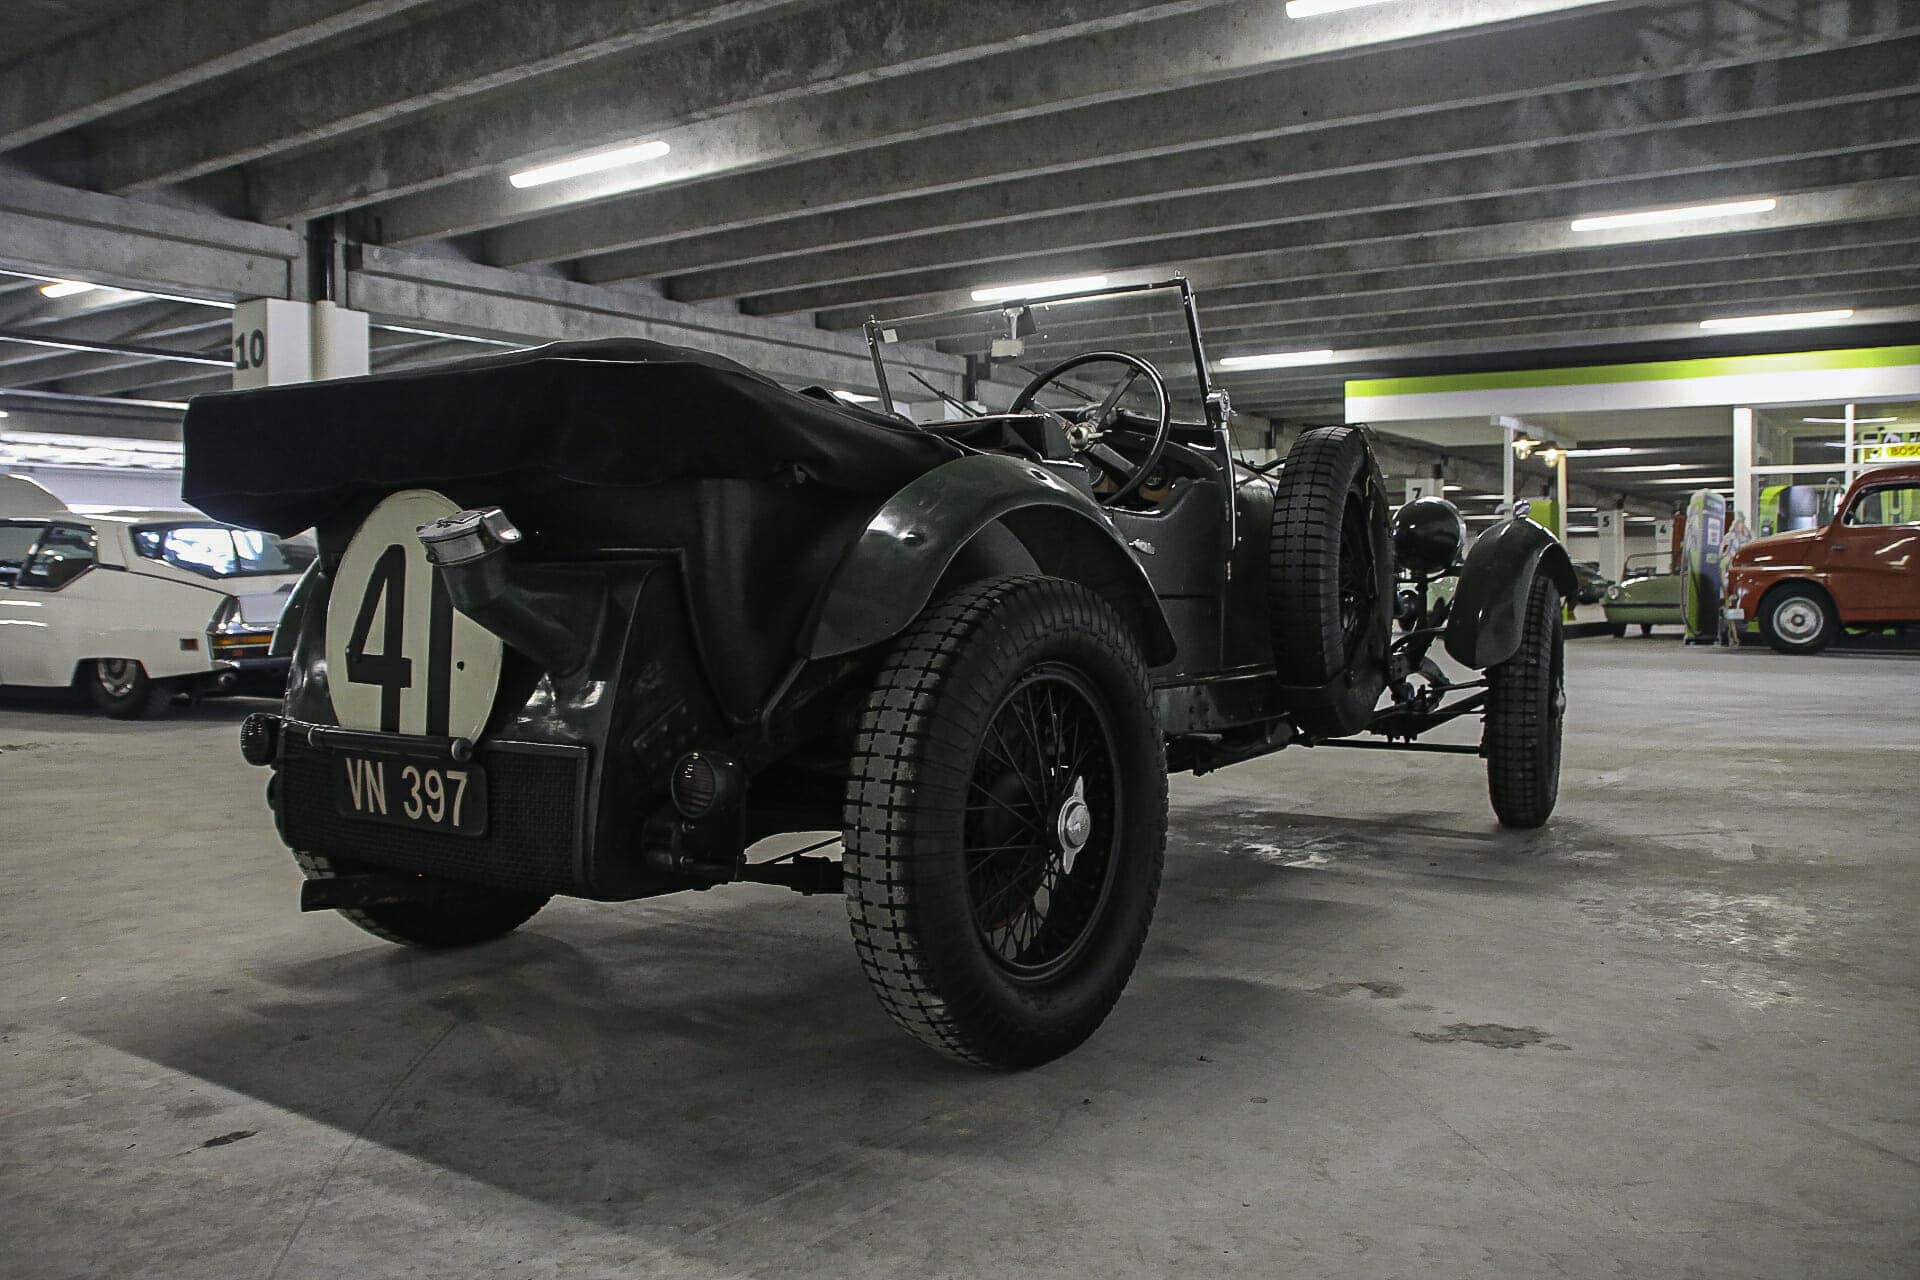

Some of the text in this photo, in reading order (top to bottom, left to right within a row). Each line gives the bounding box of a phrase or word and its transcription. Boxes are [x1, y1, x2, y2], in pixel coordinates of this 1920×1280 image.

[235, 329, 265, 370] 10
[1412, 487, 1422, 499] 7
[1602, 515, 1610, 528] 5
[345, 543, 455, 737] 41
[345, 757, 468, 827] VN 397
